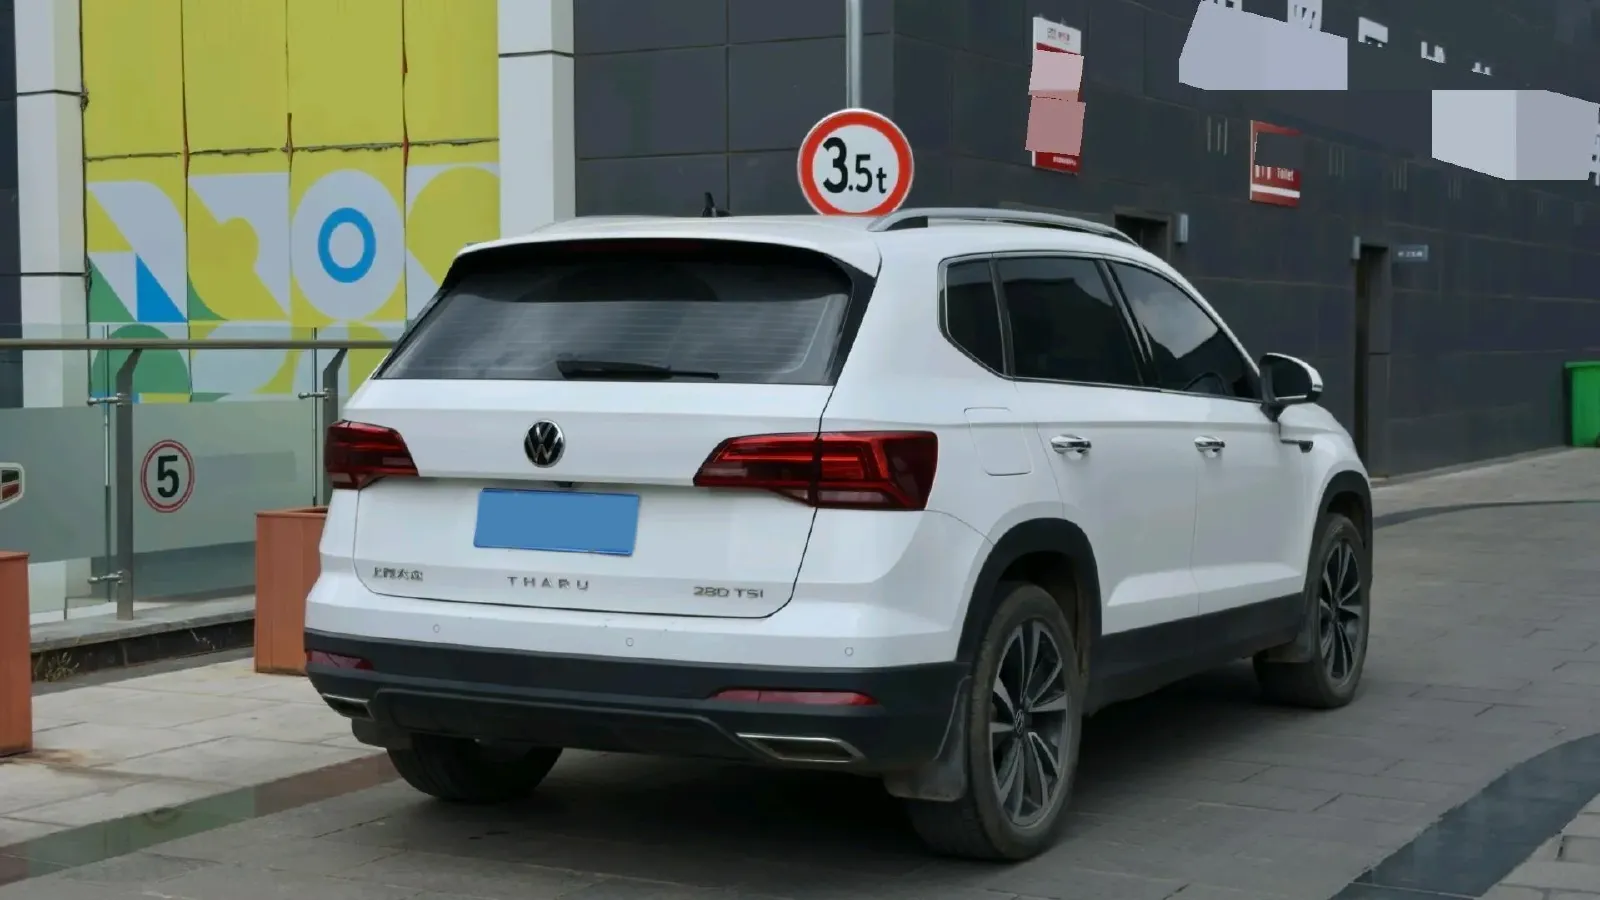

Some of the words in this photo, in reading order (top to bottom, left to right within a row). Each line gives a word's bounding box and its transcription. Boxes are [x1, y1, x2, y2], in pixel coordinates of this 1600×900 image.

[157, 455, 179, 498] 5
[507, 576, 589, 591] THARU
[734, 587, 764, 599] TSI
